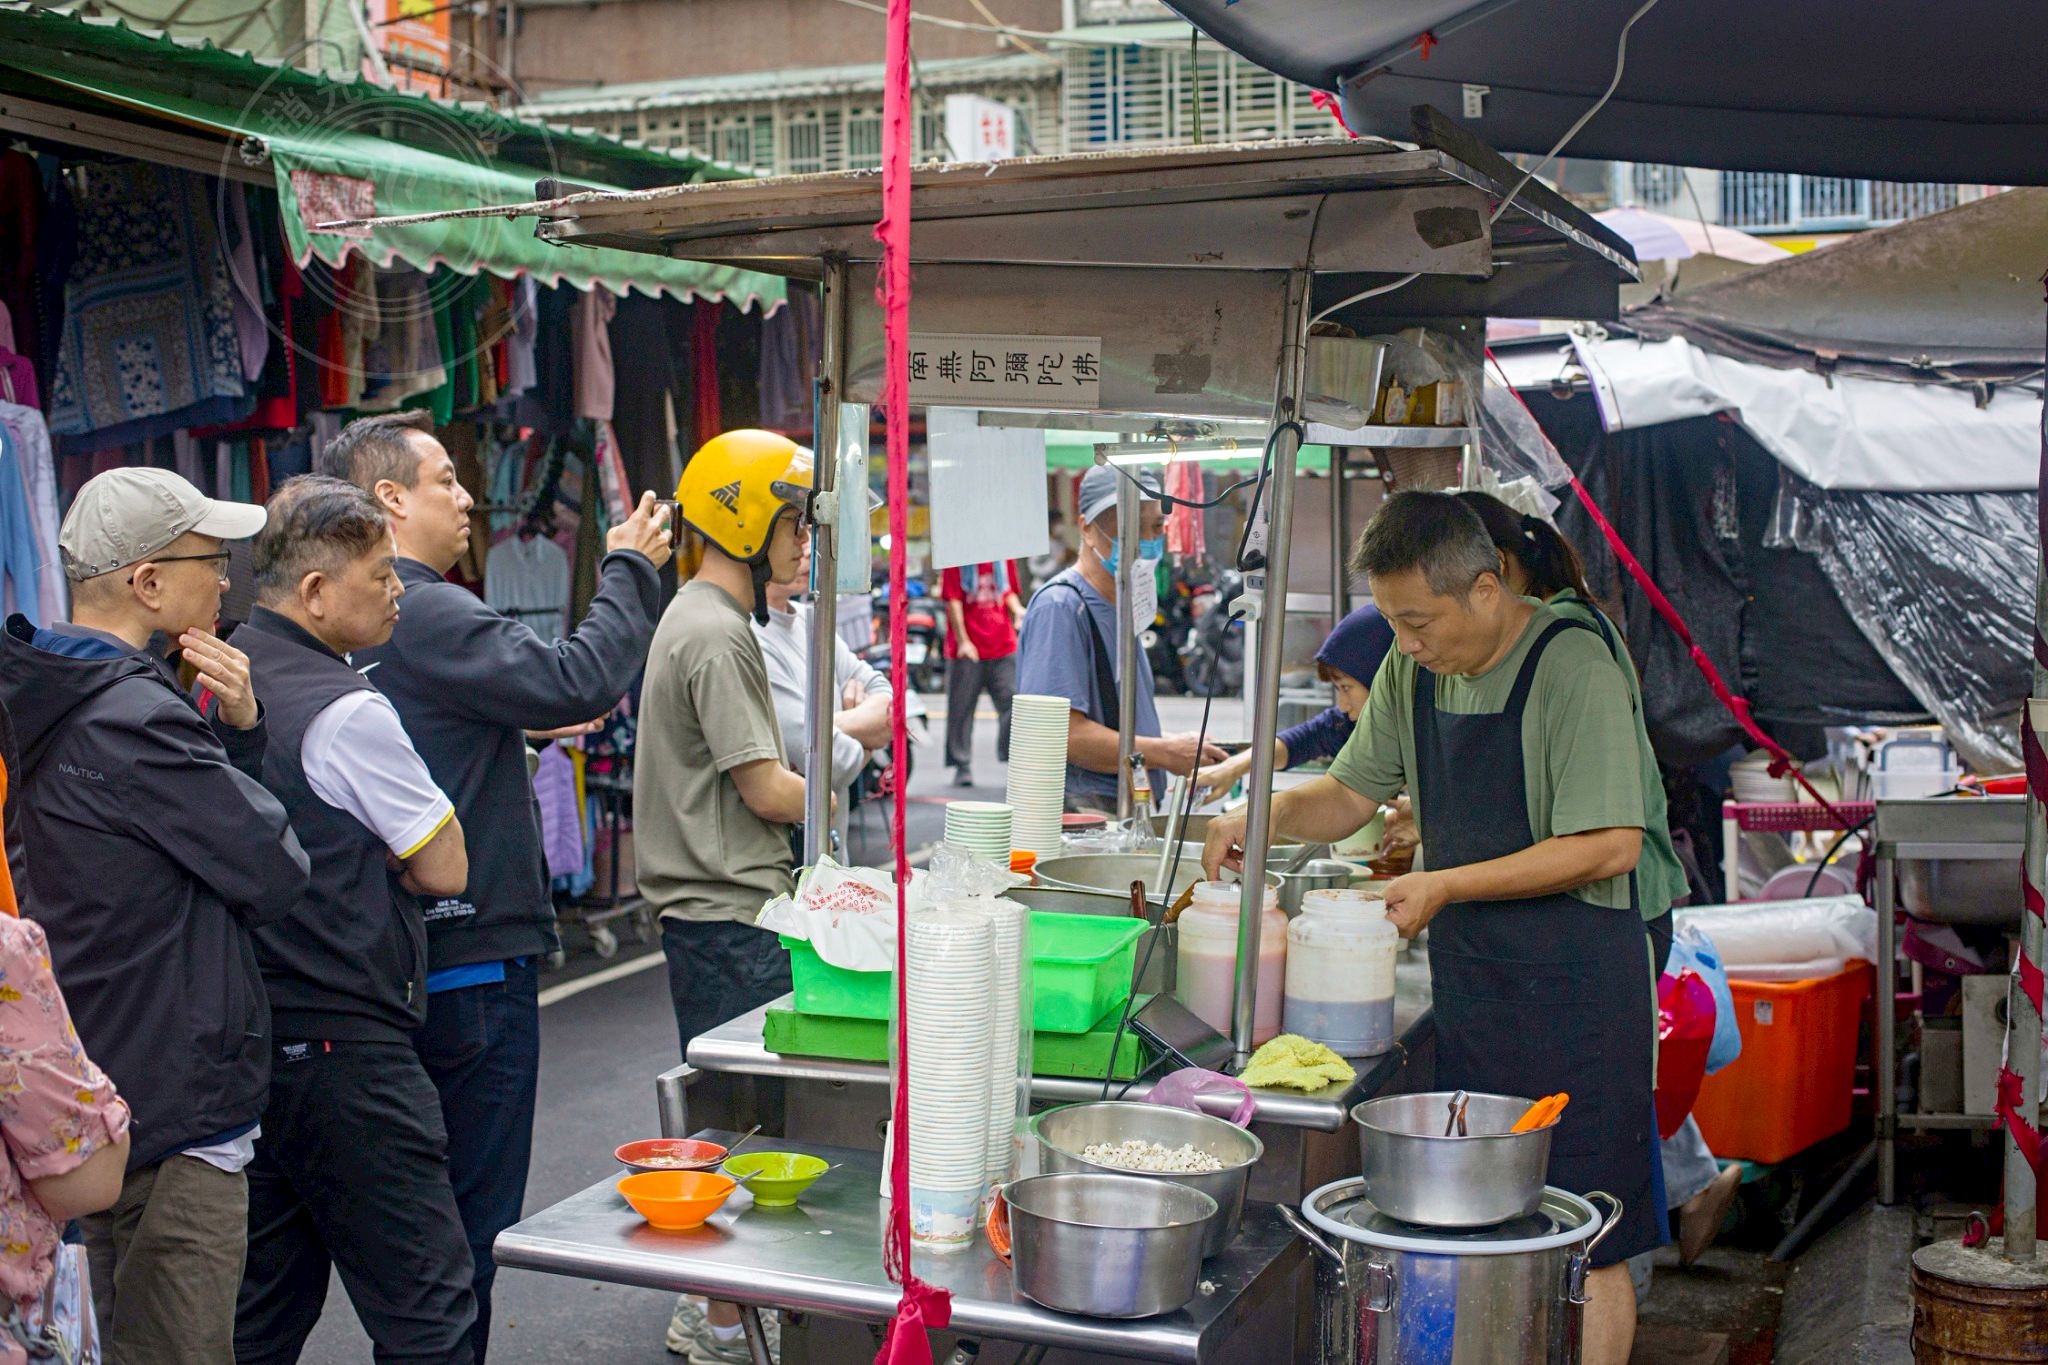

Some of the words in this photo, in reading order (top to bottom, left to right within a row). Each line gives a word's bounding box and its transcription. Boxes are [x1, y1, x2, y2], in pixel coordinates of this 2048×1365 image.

[908, 349, 1099, 386] 南無阿彌陀佛
[58, 762, 105, 782] NAUTICA
